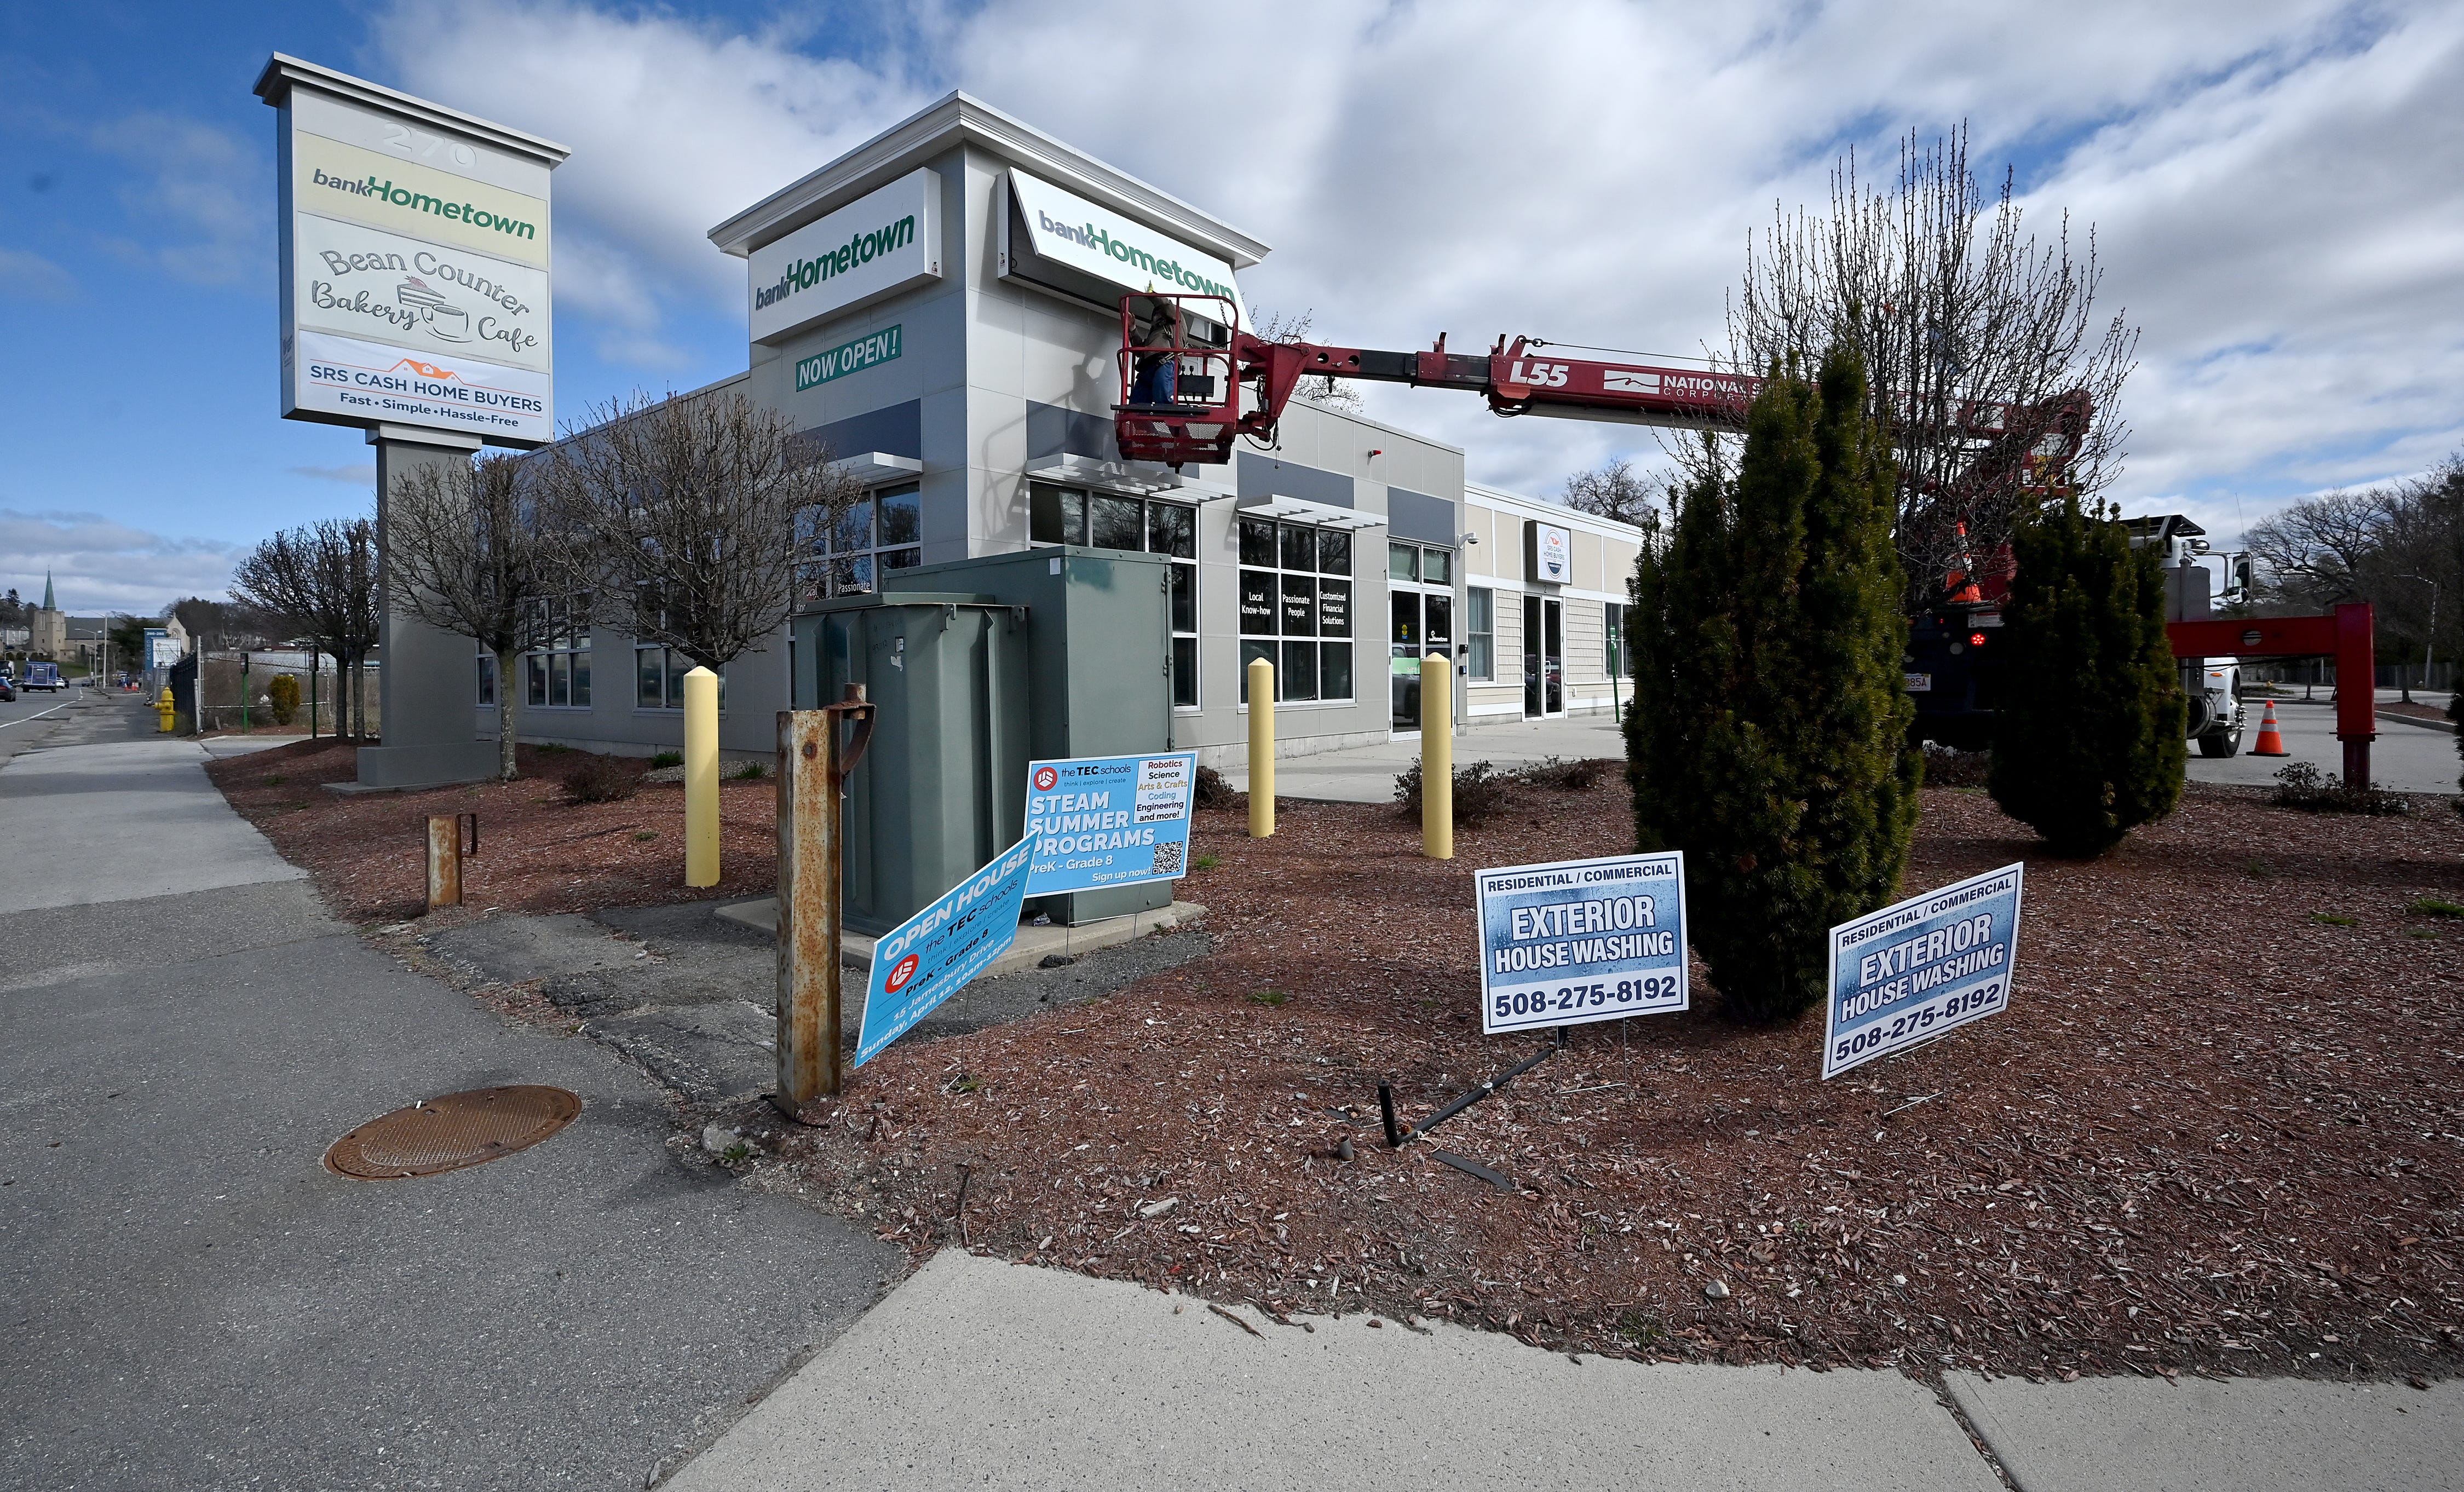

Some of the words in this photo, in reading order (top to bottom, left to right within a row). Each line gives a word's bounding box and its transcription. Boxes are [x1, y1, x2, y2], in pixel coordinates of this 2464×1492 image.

[384, 122, 477, 168] 270
[313, 168, 536, 240] bankHometown
[755, 214, 915, 311] bankHometown
[319, 250, 407, 276] Bean
[414, 251, 530, 316] Counter
[311, 280, 420, 331] Bakery
[478, 316, 538, 353] Cafe
[798, 352, 837, 387] NOW
[842, 330, 897, 371] OPEN!
[1510, 361, 1569, 387] L55
[310, 365, 349, 383] SRS
[355, 372, 407, 391] CASH
[414, 381, 469, 401] HOME
[475, 391, 542, 412] BUYERS
[340, 392, 372, 406] Fast
[382, 399, 431, 415] Simple
[440, 407, 519, 427] Hassle-Free
[838, 581, 870, 593] Passionate
[1249, 591, 1263, 602] Local
[1282, 594, 1310, 604] Passionate
[1320, 591, 1346, 601] Customized
[1544, 585, 1547, 593] 2
[1242, 604, 1270, 615] Know-how
[1288, 607, 1305, 618] People
[1322, 616, 1344, 625] Solutions
[1323, 603, 1344, 613] Financial
[1062, 768, 1075, 777] the
[1101, 764, 1131, 774] schools
[1148, 760, 1183, 769] Robotics
[1148, 770, 1180, 780] Science
[1138, 782, 1154, 791] Arts
[1156, 781, 1162, 790] &
[1164, 780, 1188, 789] Crafts
[1148, 791, 1176, 801] Coding
[1030, 791, 1109, 815] STEAM
[1137, 801, 1184, 813] Engineering
[1139, 813, 1154, 822] and
[1156, 811, 1179, 820] more!
[1030, 811, 1129, 837] SUMMER
[1066, 856, 1103, 870] Grade
[1106, 855, 1113, 866] 8
[1092, 873, 1113, 883] Sign
[1115, 872, 1127, 880] up
[1129, 867, 1151, 877] now!
[1488, 873, 1573, 892] RESIDENTIAL
[1584, 864, 1672, 882] COMMERCIAL
[884, 900, 953, 960] OPEN
[956, 843, 1030, 913] HOUSE
[1842, 909, 1920, 947] RESIDENTIAL
[1931, 878, 2012, 914] COMMERCIAL
[925, 935, 945, 954] the
[978, 879, 1018, 914] schools
[1511, 895, 1655, 941] EXTERIOR
[928, 947, 947, 964] think
[954, 920, 982, 944] explore
[988, 899, 1009, 919] create
[905, 967, 935, 997] PreK
[945, 937, 979, 966] Grade
[982, 928, 988, 939] 8
[1495, 941, 1569, 973] HOUSE
[1572, 931, 1674, 964] WASHING
[1860, 913, 1993, 988] EXTERIOR
[894, 1007, 906, 1021] 15
[908, 960, 967, 1010] Jamesbury
[969, 939, 994, 963] Drive
[1841, 976, 1910, 1023] HOUSE
[1912, 943, 2005, 994] WASHING
[860, 1021, 907, 1058] Sunday,
[909, 995, 936, 1021] April
[956, 936, 1011, 985] 10am-12pm
[1495, 976, 1677, 1018] 508-275-8192
[1836, 983, 2000, 1061] 508-275-8192
